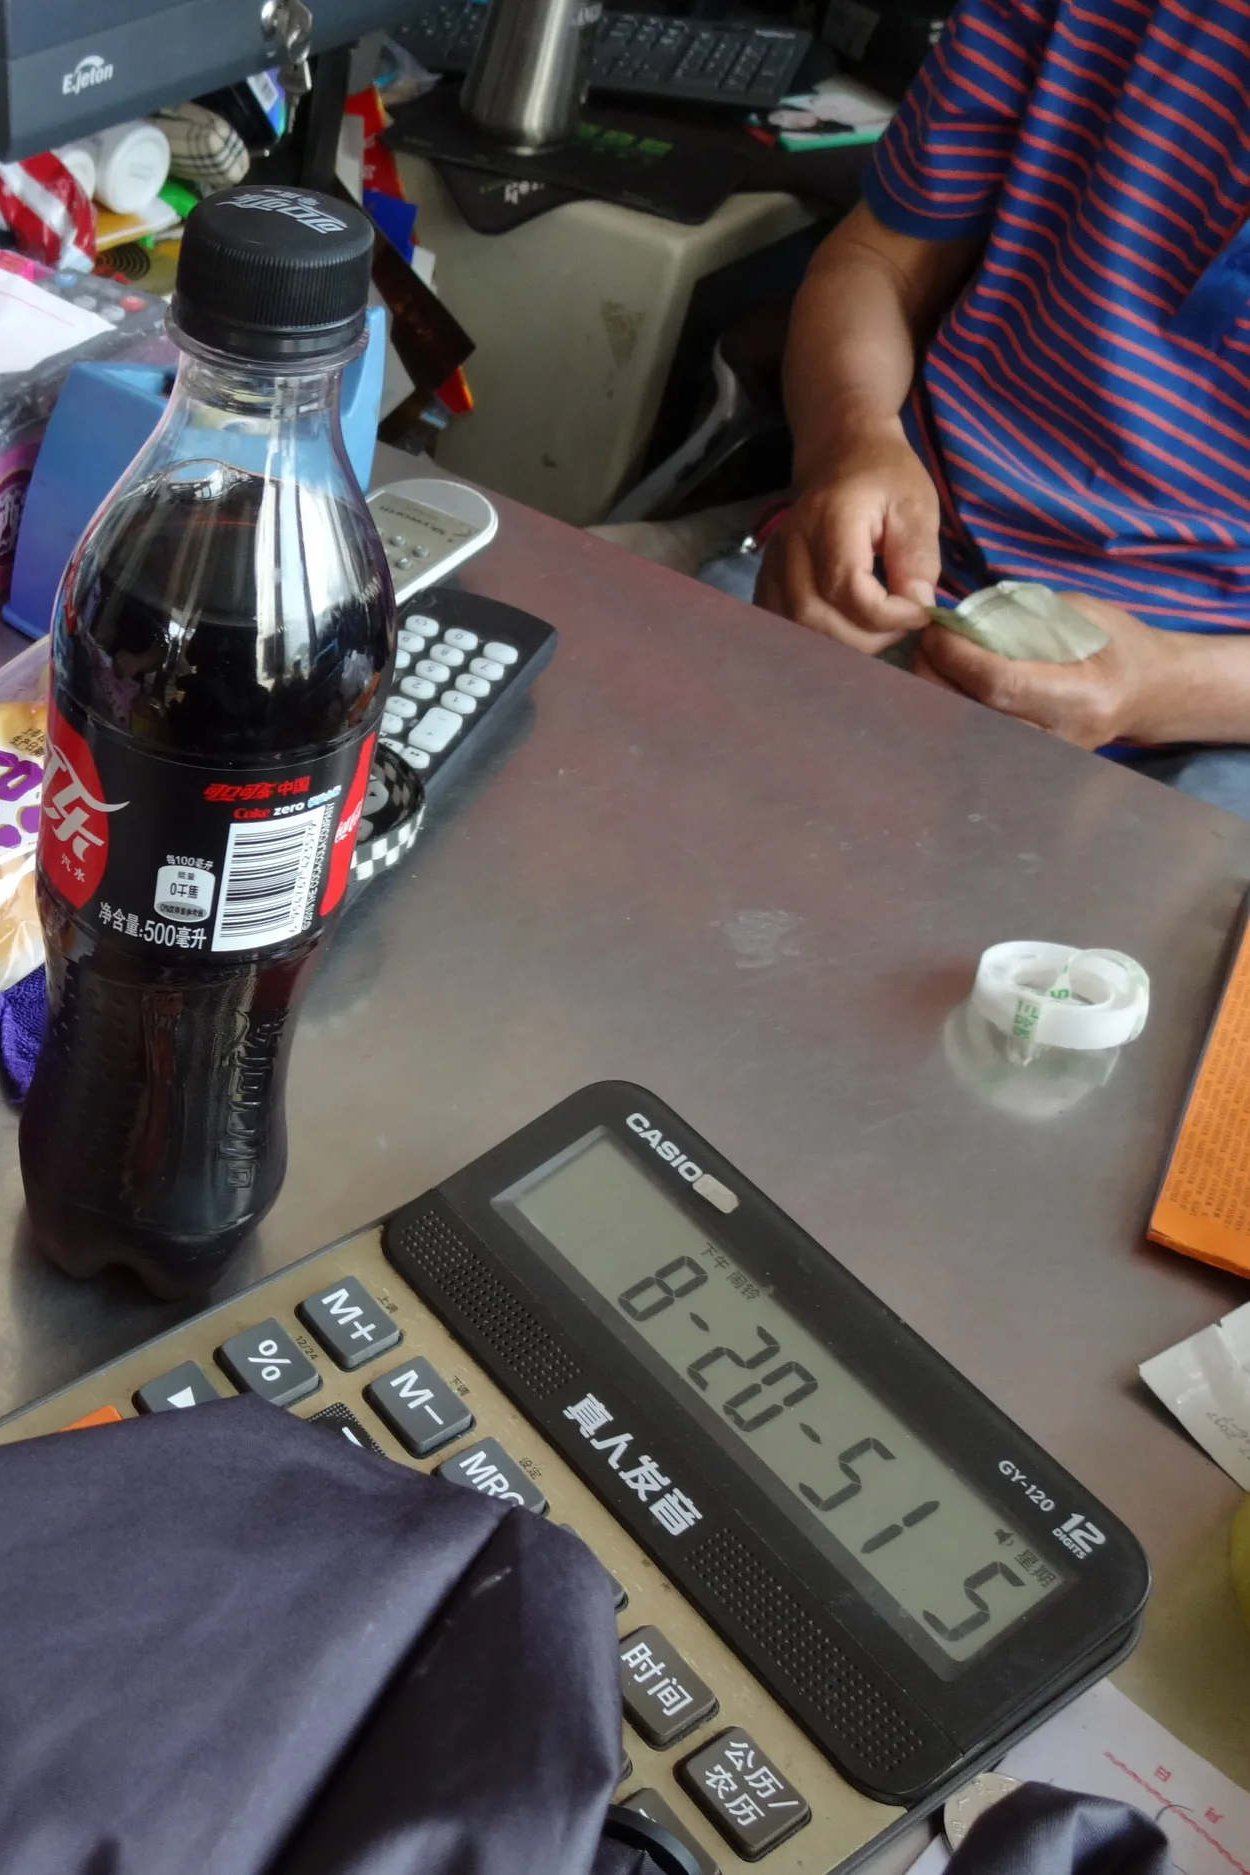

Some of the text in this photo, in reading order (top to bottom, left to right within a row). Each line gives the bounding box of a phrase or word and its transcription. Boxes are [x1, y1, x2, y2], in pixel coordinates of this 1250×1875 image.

[273, 802, 305, 817] zero
[626, 1112, 703, 1182] CASIO
[700, 1240, 730, 1271] 下午
[321, 1287, 377, 1342] M+
[376, 1293, 400, 1314] 上调
[248, 1339, 291, 1382] %
[294, 1335, 319, 1361] 12/24
[450, 1374, 471, 1397] 下调
[617, 1255, 940, 1554] 8-20-51
[518, 1455, 542, 1480] 设定
[562, 1393, 703, 1536] 真人发音
[998, 1459, 1055, 1512] GY-120
[1051, 1527, 1087, 1560] DIGITS
[1060, 1512, 1106, 1553] 12
[1014, 1549, 1057, 1588] 星期
[922, 1561, 1027, 1641] 5
[620, 1642, 694, 1717] 时间
[704, 1763, 766, 1828] 农历
